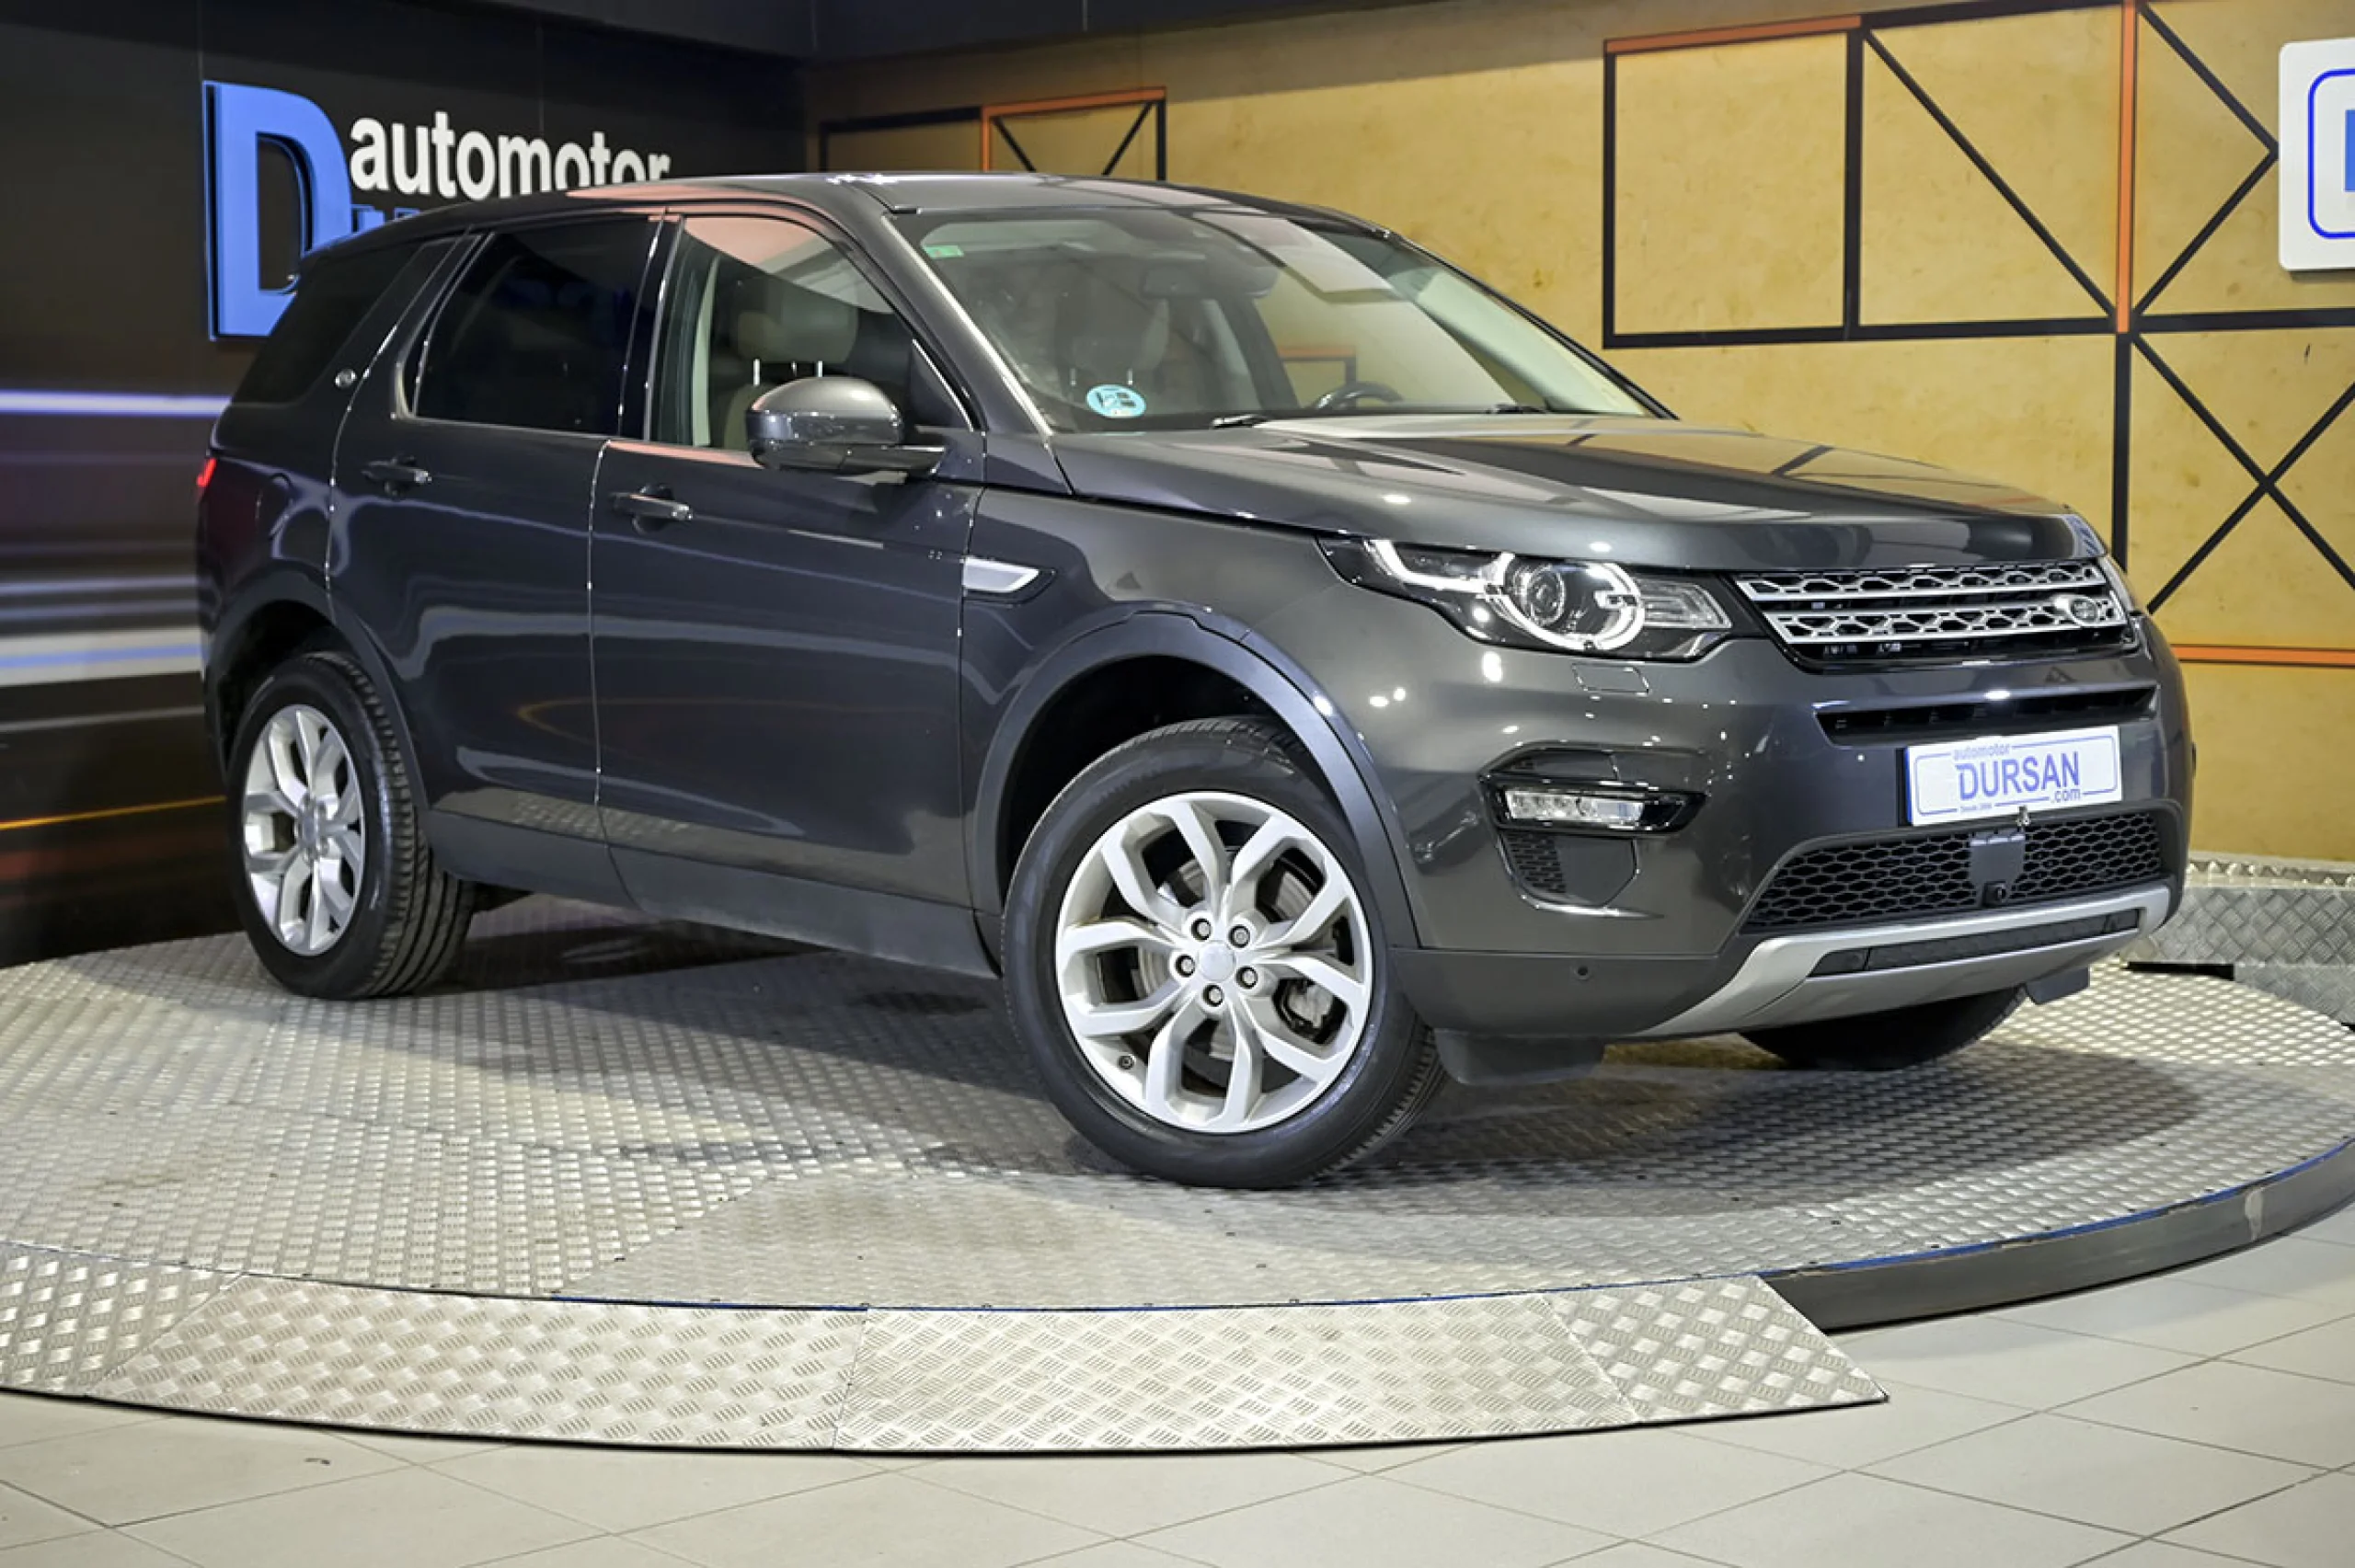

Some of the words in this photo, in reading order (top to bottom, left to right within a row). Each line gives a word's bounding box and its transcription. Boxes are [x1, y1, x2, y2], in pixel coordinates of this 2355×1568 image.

[350, 110, 672, 200] automotor
[1955, 751, 2079, 800] DURSAN
[2050, 788, 2082, 804] .com
